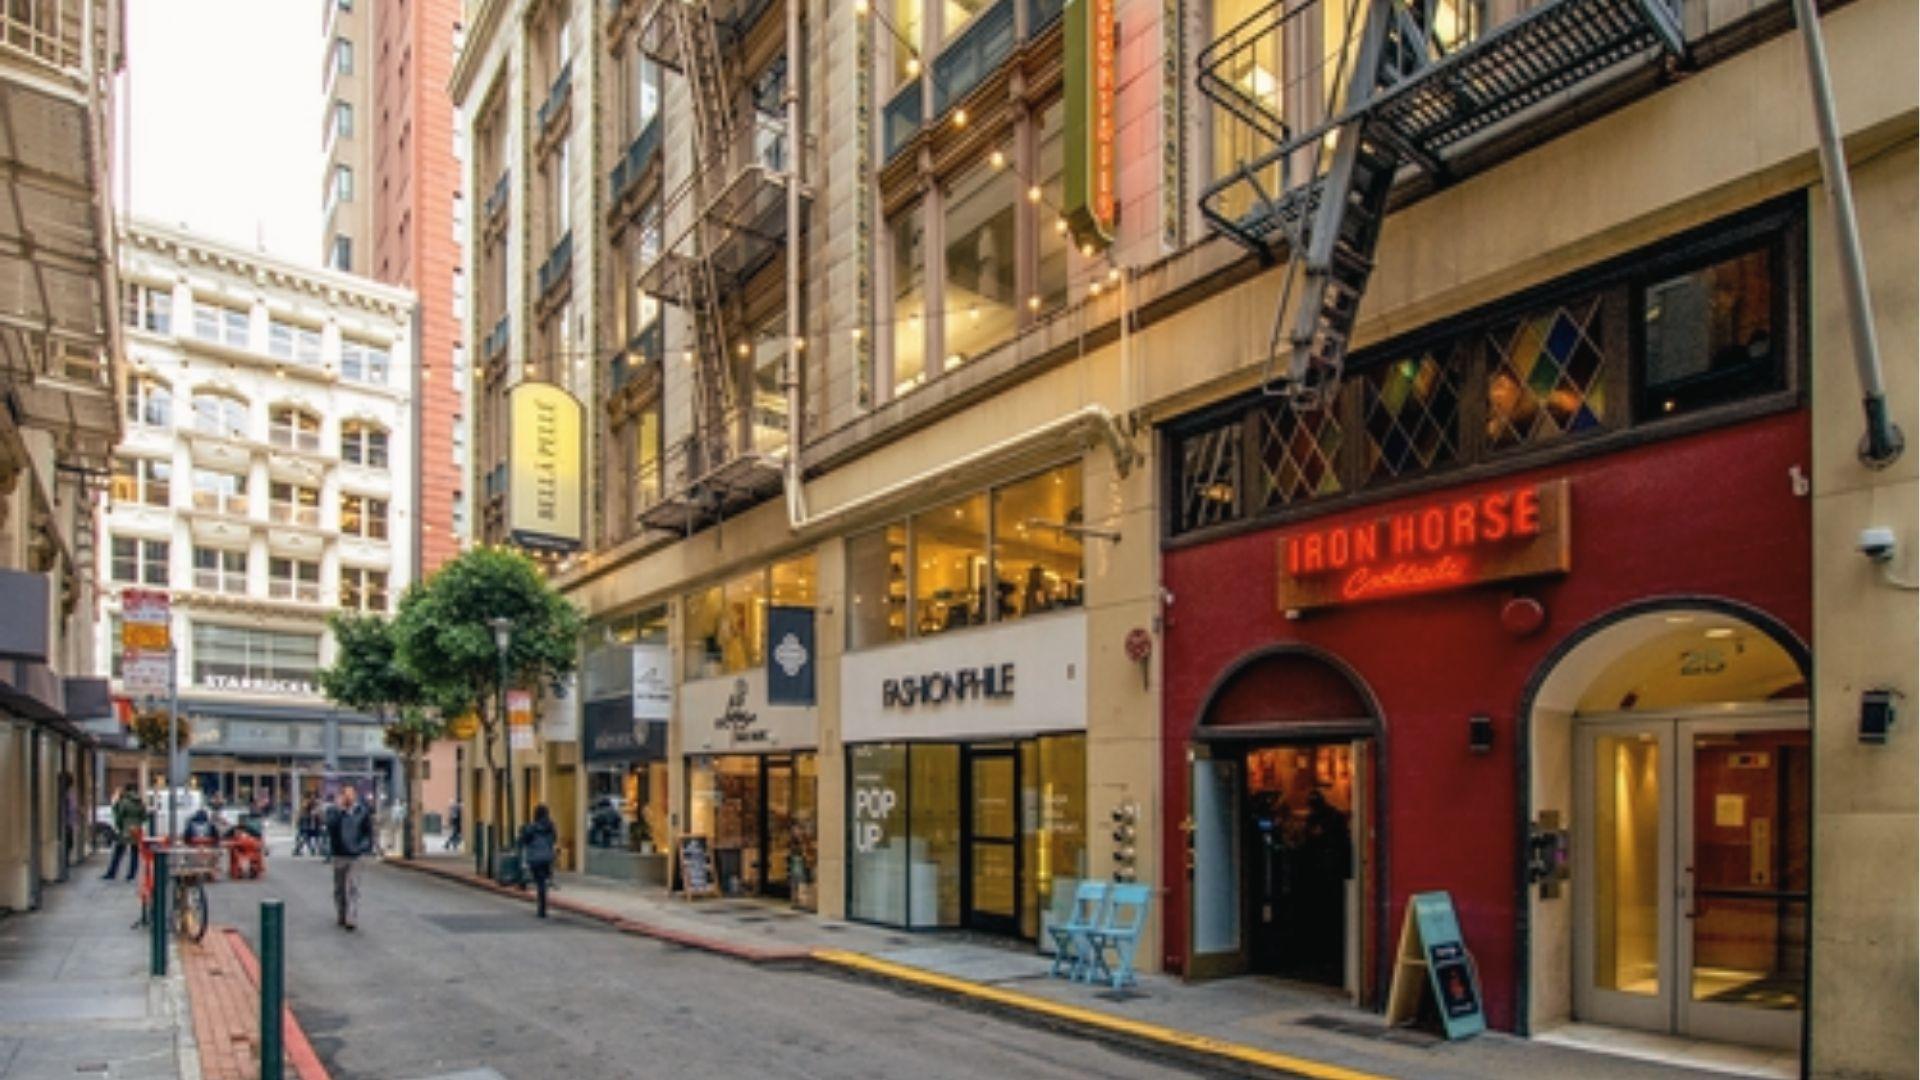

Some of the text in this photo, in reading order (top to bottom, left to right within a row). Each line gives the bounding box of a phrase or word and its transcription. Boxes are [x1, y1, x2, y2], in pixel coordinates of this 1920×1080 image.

[1287, 486, 1540, 573] IRON HORSE
[204, 673, 312, 696] STARBUCKS
[882, 662, 1015, 708] FASHIONPHILE
[856, 790, 896, 819] POP
[856, 823, 883, 854] UP
